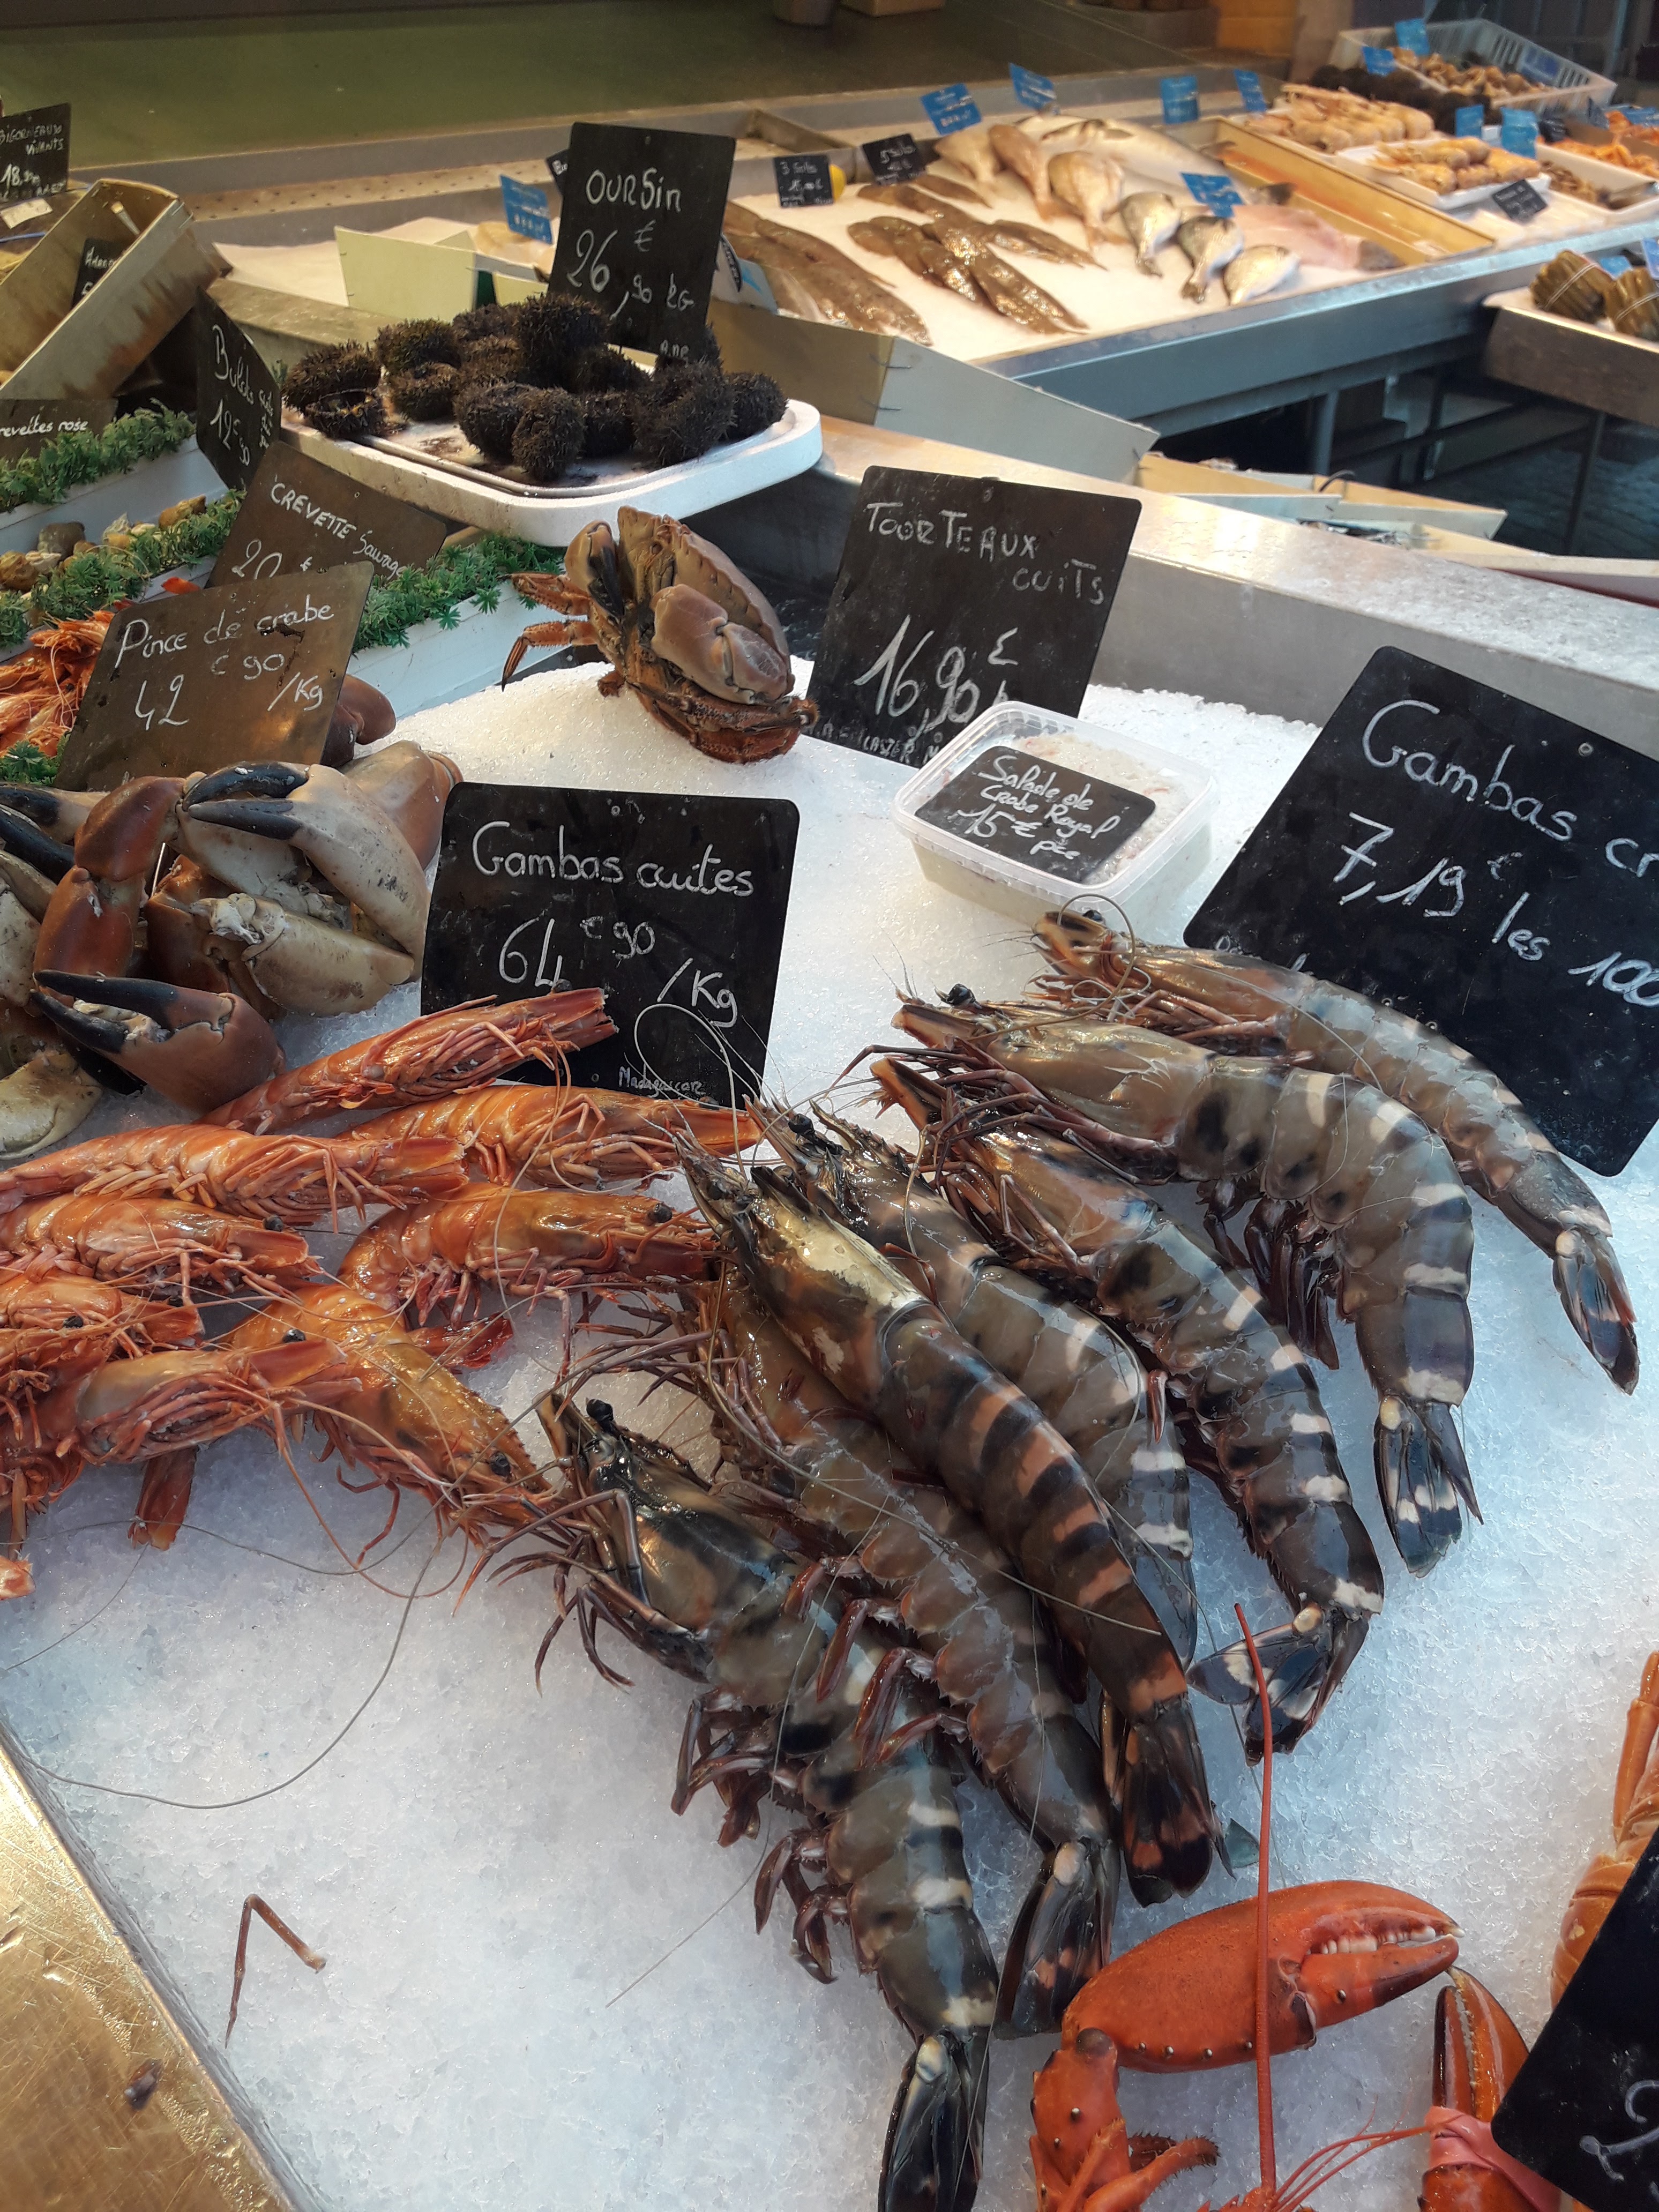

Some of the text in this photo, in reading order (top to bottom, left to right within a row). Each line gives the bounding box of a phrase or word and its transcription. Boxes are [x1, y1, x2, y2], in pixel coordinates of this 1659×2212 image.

[270, 482, 357, 540] CREVETTE
[256, 594, 334, 632] crabe
[977, 754, 1094, 810] Salade de
[1362, 699, 1577, 842] Gambas
[472, 821, 754, 897] Gambas cuites
[498, 916, 563, 988] 64
[1491, 892, 1551, 962] les
